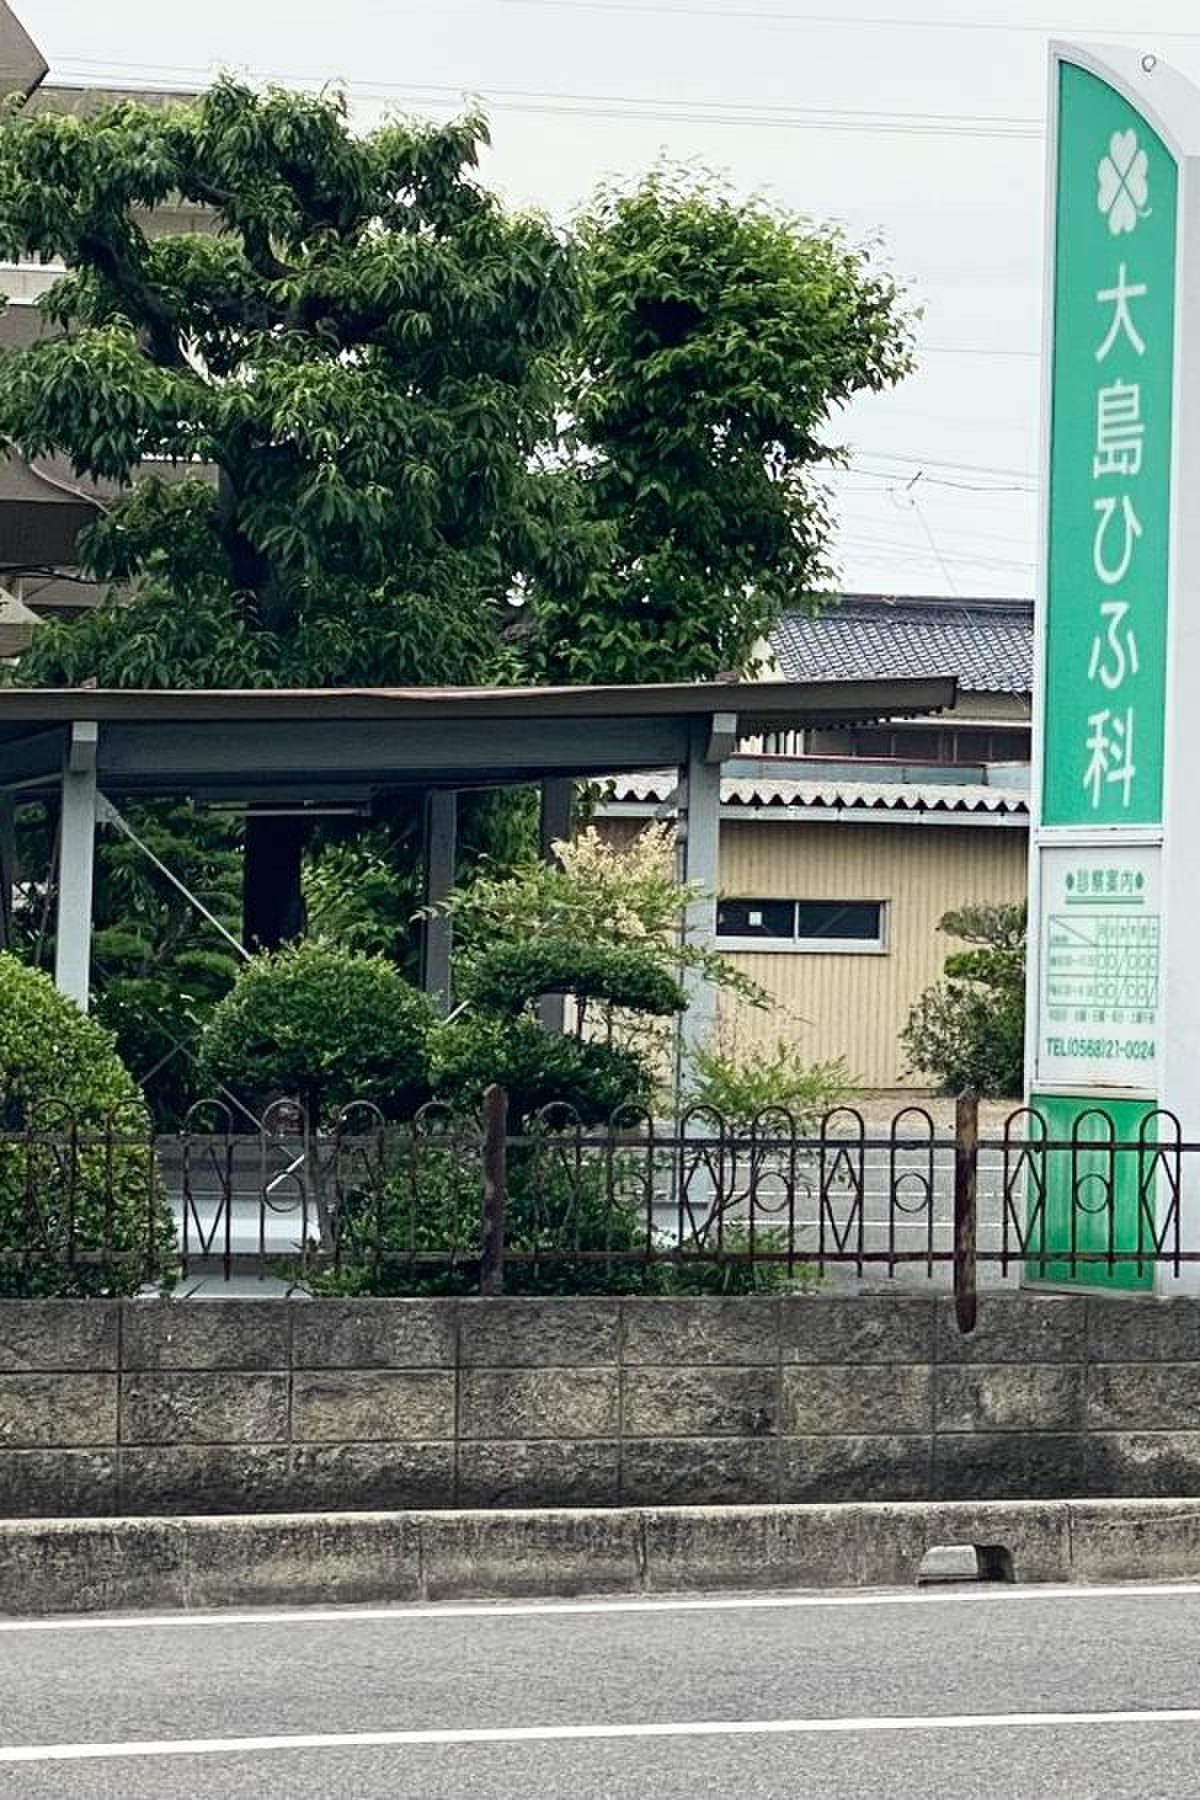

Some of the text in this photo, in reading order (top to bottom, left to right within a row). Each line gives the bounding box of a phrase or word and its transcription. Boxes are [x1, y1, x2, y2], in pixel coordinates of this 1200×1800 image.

[1084, 265, 1146, 806] 大島ひふ科
